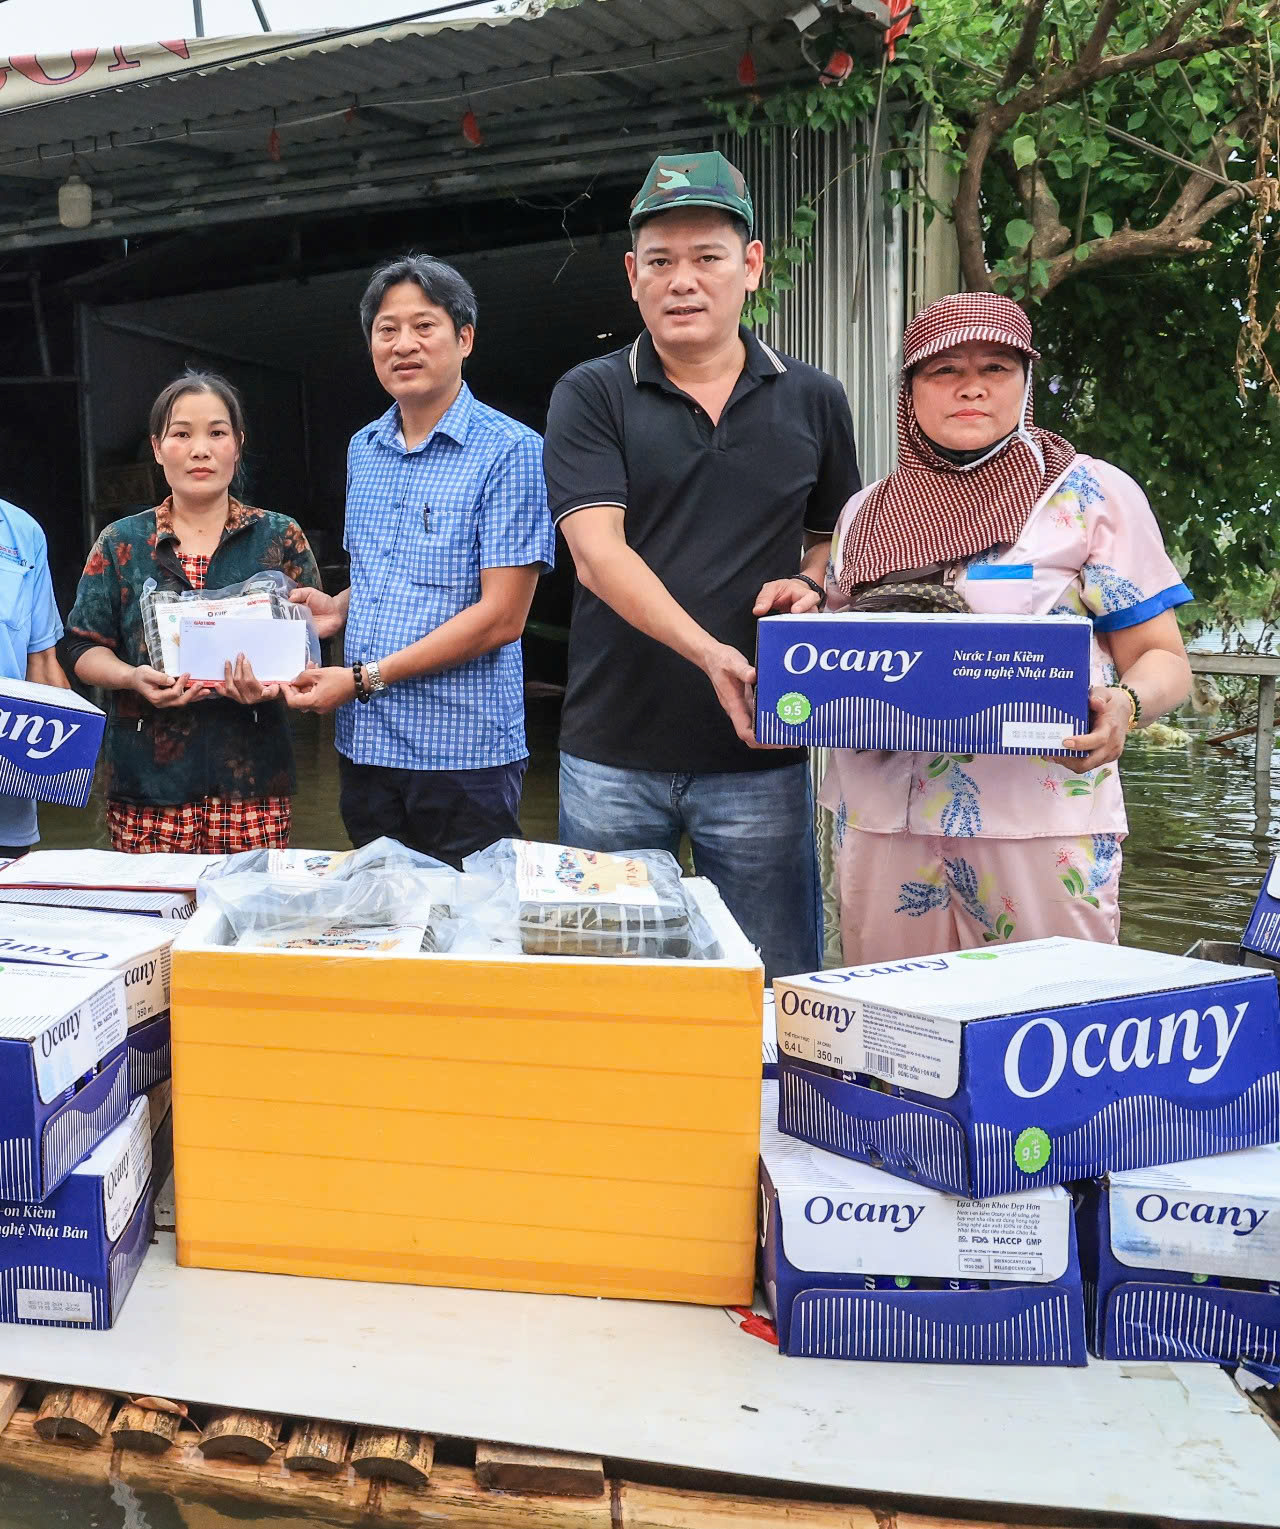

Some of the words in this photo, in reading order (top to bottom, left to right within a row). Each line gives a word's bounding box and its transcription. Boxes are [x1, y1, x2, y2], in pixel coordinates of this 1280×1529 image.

[783, 642, 923, 683] Ocany
[953, 650, 984, 663] Nước
[987, 651, 1011, 663] I-on
[1013, 649, 1045, 663] Kiềm
[952, 666, 982, 679] công
[984, 666, 1014, 681] nghệ
[1016, 666, 1047, 681] Nhật
[1049, 667, 1075, 680] Bản
[171, 898, 197, 920] Ocan
[124, 958, 158, 987] cany
[809, 958, 950, 984] Ocany
[781, 990, 856, 1033] Ocany
[41, 1008, 82, 1058] Ocany
[784, 1040, 796, 1052] 8,4
[797, 1043, 803, 1054] L
[816, 1049, 832, 1062] 350
[833, 1055, 843, 1065] ml
[1004, 1001, 1251, 1099] Ocany
[108, 1148, 130, 1200] Ocany
[22, 1203, 56, 1219] Kiềm
[804, 1196, 926, 1233] Ocany
[972, 1200, 990, 1210] Chọn
[1026, 1203, 1041, 1211] Hơn
[1135, 1194, 1270, 1236] Ocany
[27, 1223, 59, 1239] Nhật
[62, 1226, 88, 1240] Bản
[971, 1236, 989, 1244] FDA
[993, 1236, 1022, 1245] HACCP
[1025, 1238, 1042, 1246] GMP
